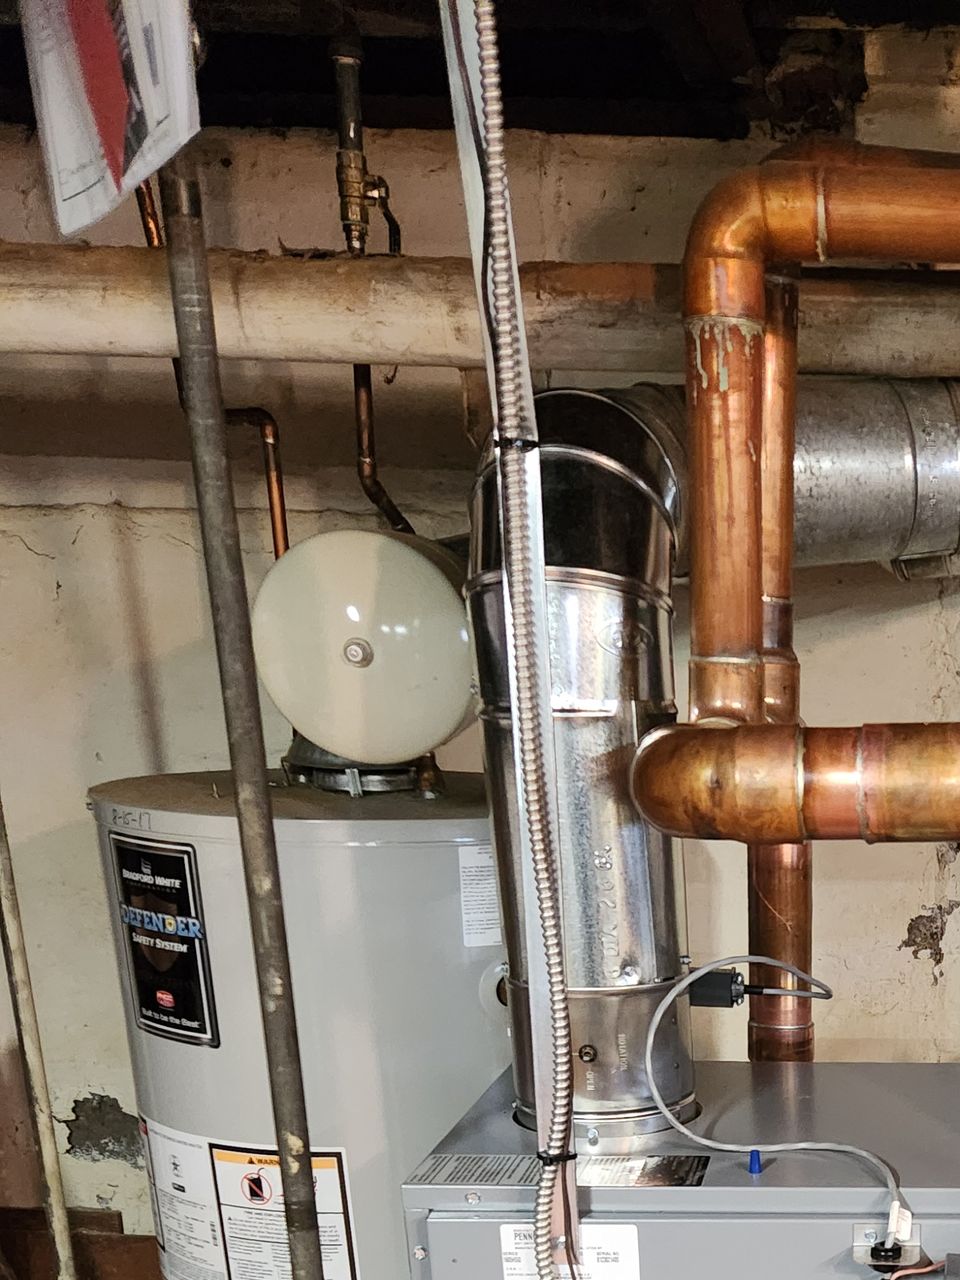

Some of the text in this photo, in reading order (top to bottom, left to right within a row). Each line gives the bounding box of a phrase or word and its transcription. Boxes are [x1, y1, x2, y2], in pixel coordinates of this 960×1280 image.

[122, 868, 182, 889] BRADFORD WHITE
[120, 903, 204, 939] DEFENDER
[585, 1071, 596, 1091] OPEN
[256, 1158, 281, 1167] WARN
